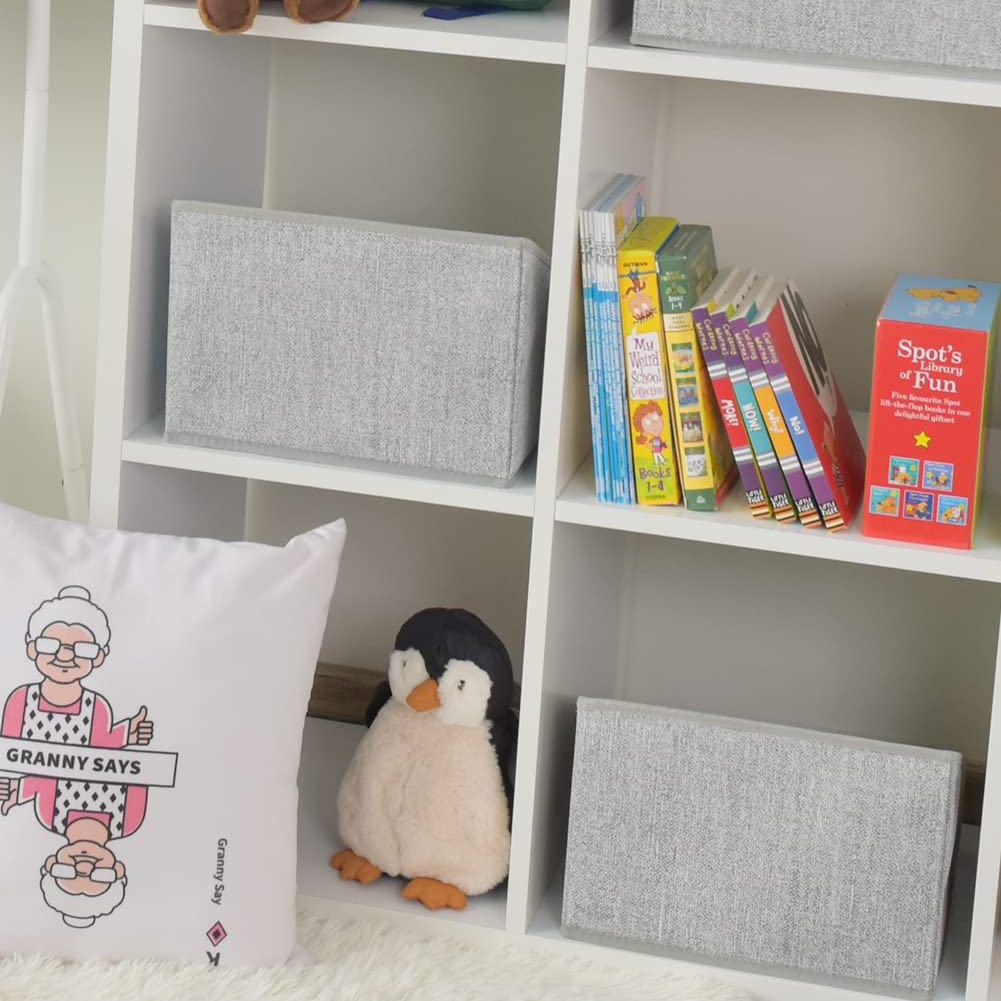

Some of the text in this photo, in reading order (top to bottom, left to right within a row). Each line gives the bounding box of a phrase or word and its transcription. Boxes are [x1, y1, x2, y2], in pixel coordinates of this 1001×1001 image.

[629, 350, 660, 368] Weird
[897, 339, 963, 364] Spot's
[631, 367, 662, 385] School
[920, 360, 964, 377] Library
[899, 370, 957, 393] of Fun
[879, 398, 971, 417] lift-the-flap books in one
[891, 391, 961, 408] Five favourite Spot
[721, 400, 739, 427] MORE!
[742, 403, 762, 432] NOW!
[894, 409, 930, 421] delightful
[638, 466, 672, 480] Books
[647, 480, 665, 492] 1-4
[6, 748, 142, 775] GRANNY SAYS
[211, 838, 228, 905] Granny Say
